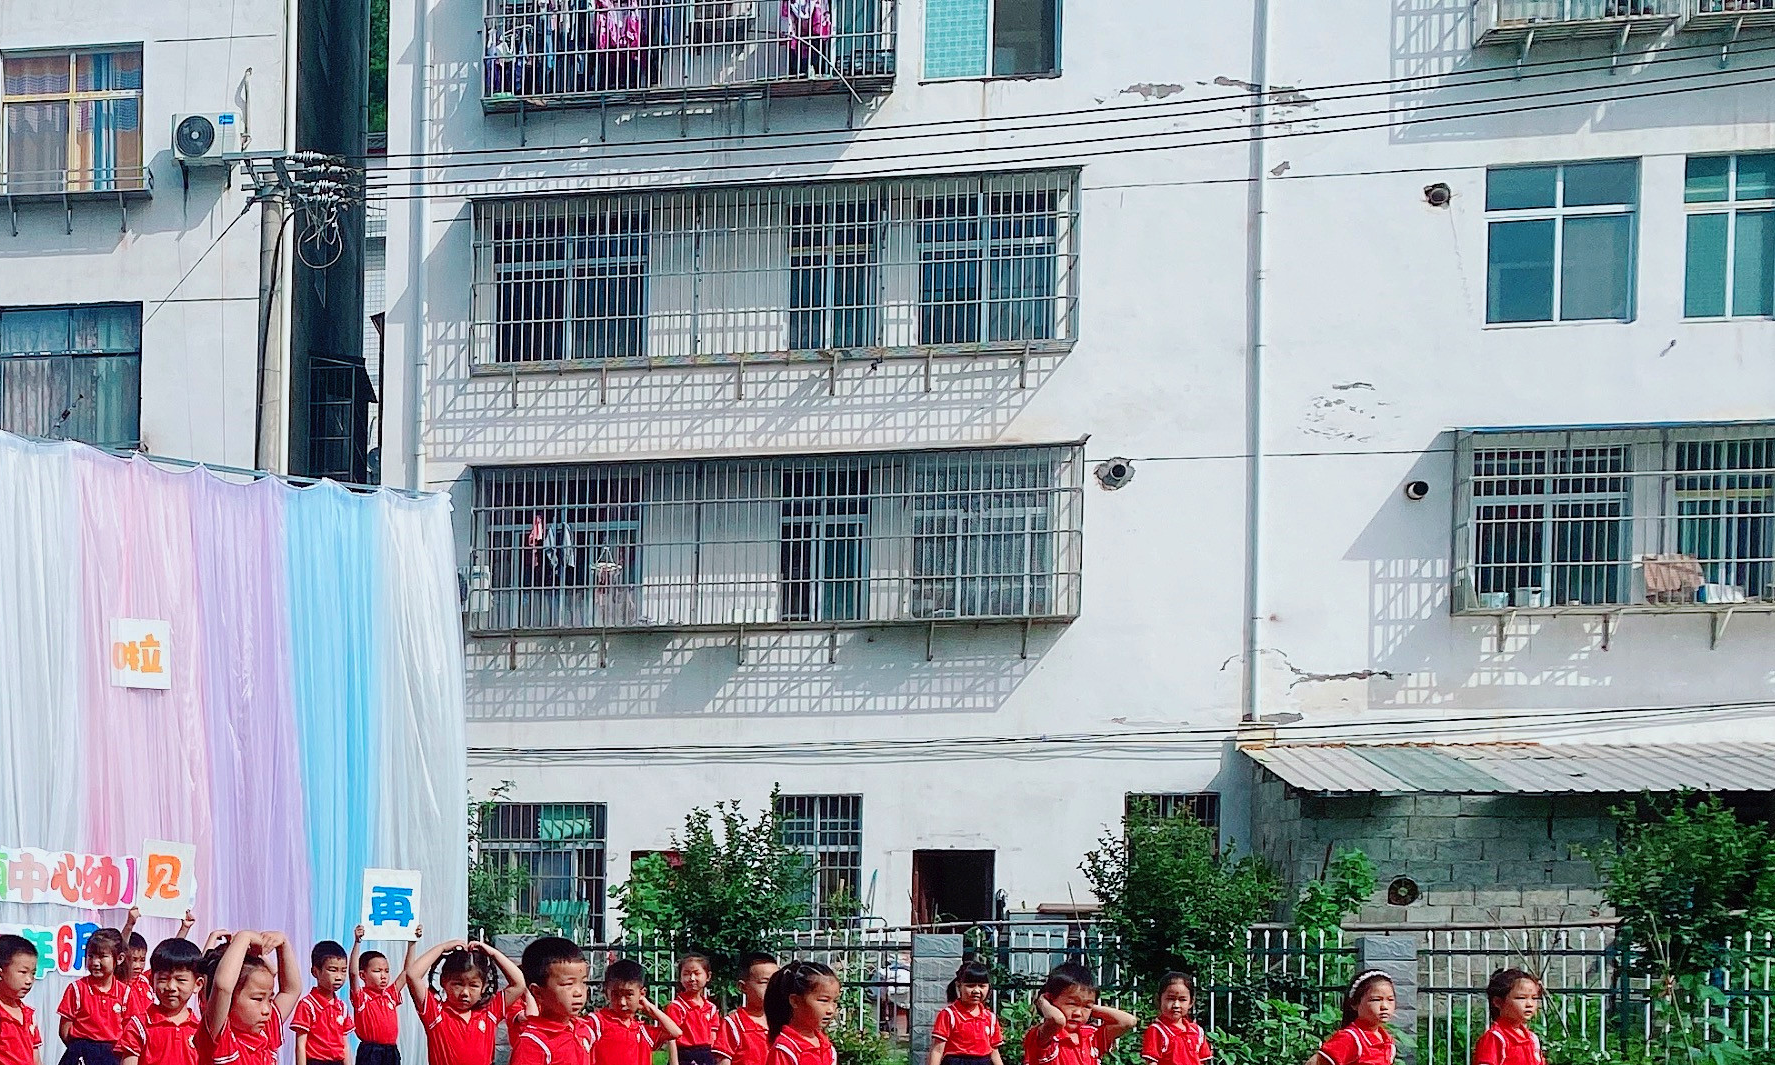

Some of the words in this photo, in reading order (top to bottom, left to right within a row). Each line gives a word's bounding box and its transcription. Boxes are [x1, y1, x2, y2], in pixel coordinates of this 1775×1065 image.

[113, 633, 163, 673] 啦
[145, 854, 181, 899] 见
[369, 886, 416, 928] 再
